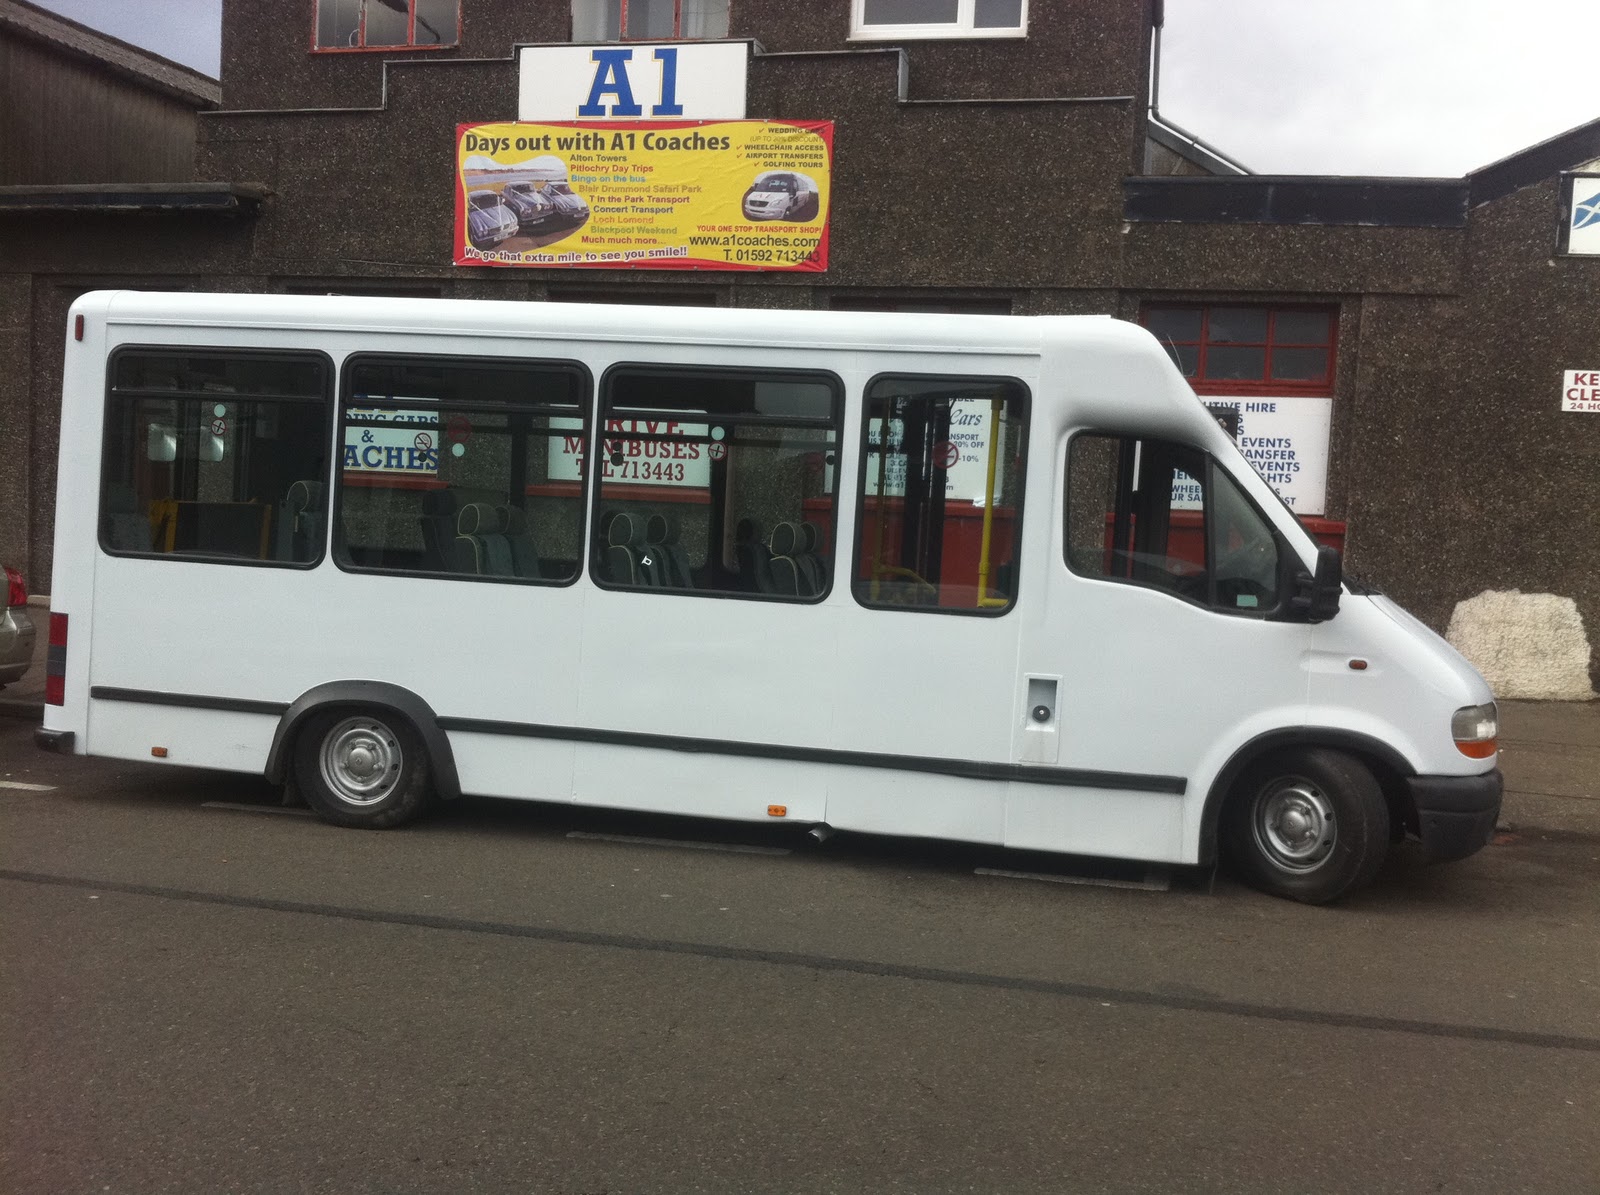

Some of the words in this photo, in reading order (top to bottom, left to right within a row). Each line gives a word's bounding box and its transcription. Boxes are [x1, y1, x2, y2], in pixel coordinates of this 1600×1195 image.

[576, 48, 683, 118] A1
[466, 134, 510, 156] Days
[515, 135, 551, 151] out
[556, 132, 605, 151] with
[611, 132, 635, 150] A1
[643, 132, 730, 150] Coaches
[570, 154, 593, 162] Alton
[596, 154, 627, 162] Towers
[570, 164, 610, 174] Pitlochry
[612, 165, 629, 174] Day
[632, 164, 654, 174] Trips
[571, 174, 597, 184] Bingo
[613, 175, 627, 183] the
[630, 175, 646, 183] bus
[579, 185, 599, 193] Blair
[602, 185, 651, 193] Drummond
[653, 185, 679, 193] Safari
[682, 185, 702, 193] Park
[589, 195, 595, 203] T
[608, 195, 622, 203] the
[624, 195, 644, 203] Park
[647, 195, 690, 205] Transport
[593, 205, 628, 213] Concert
[631, 205, 674, 215] Transport
[618, 216, 654, 224] Lomond
[591, 226, 635, 235] Blackpool
[637, 226, 678, 235] Weekend
[581, 236, 605, 244] Much
[607, 236, 632, 244] much
[689, 234, 820, 247] www.a1coaches.com
[464, 247, 481, 258] We
[482, 251, 496, 261] go
[499, 252, 522, 261] that
[524, 252, 554, 262] extra
[557, 251, 582, 262] mile
[585, 251, 597, 261] to
[600, 252, 621, 260] see
[624, 251, 645, 262] you
[648, 246, 688, 258] smile!!
[736, 249, 773, 261] 01592
[776, 250, 820, 263] 713443
[1574, 373, 1599, 386] KE
[1566, 388, 1600, 401] CLE
[1246, 403, 1276, 413] HIRE
[949, 409, 983, 426] Cars
[361, 429, 375, 443] &
[1241, 437, 1291, 448] EVENTS
[563, 436, 700, 460] MNIBUSES
[344, 445, 438, 470] ACHES
[620, 461, 685, 481] 713443
